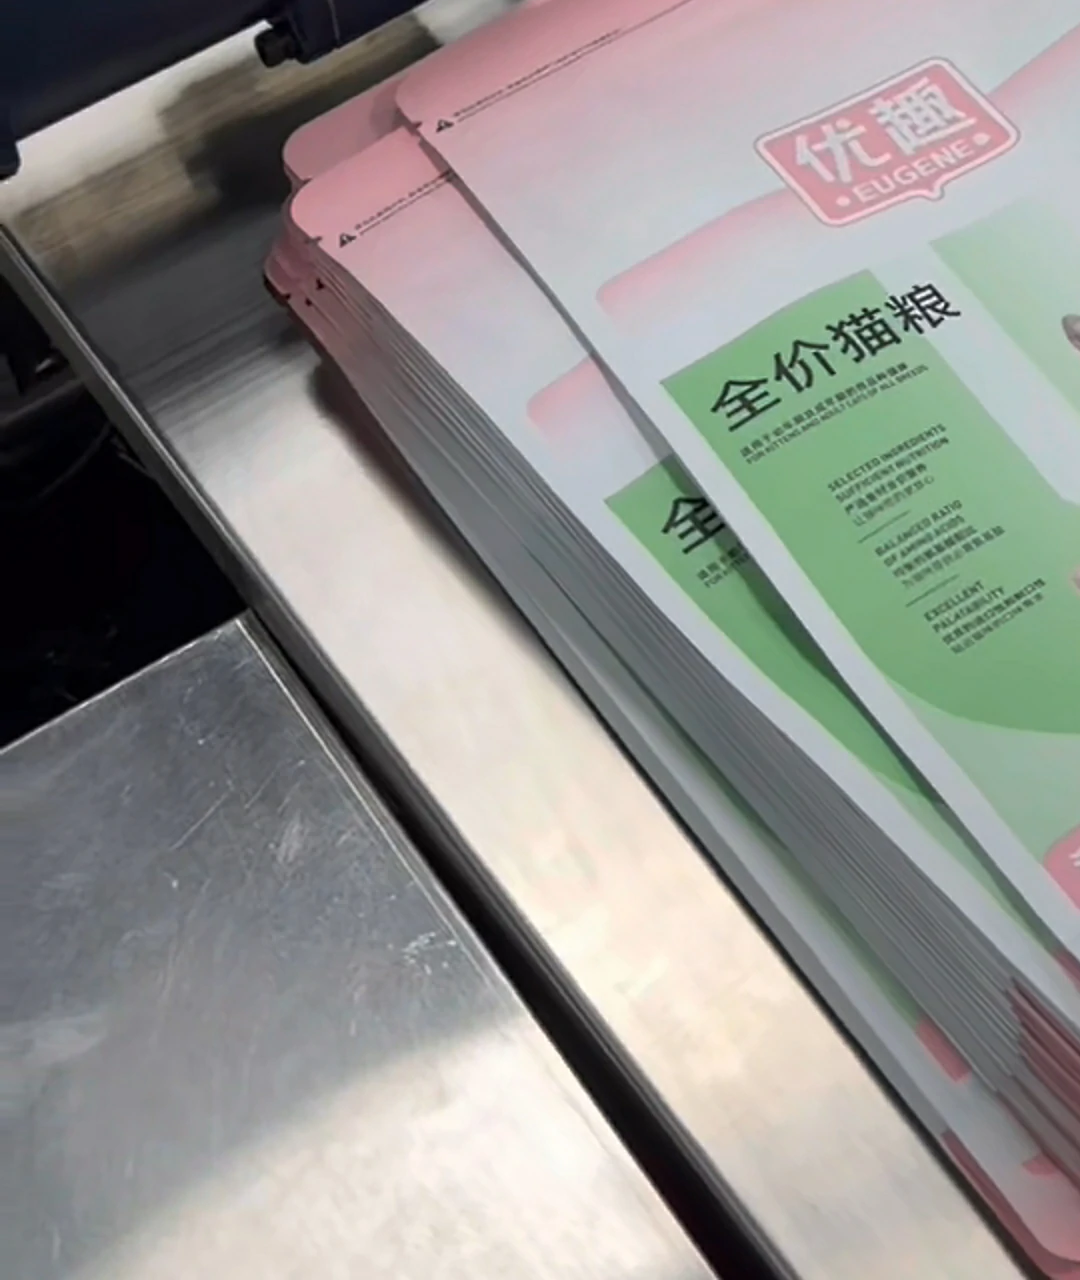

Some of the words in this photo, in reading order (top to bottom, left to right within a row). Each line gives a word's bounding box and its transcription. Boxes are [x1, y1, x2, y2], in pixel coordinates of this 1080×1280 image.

[795, 77, 978, 183] 优趣
[852, 138, 976, 204] EUGENE
[711, 283, 961, 433] 全价猫粮
[923, 580, 986, 623] EXCELLENT
